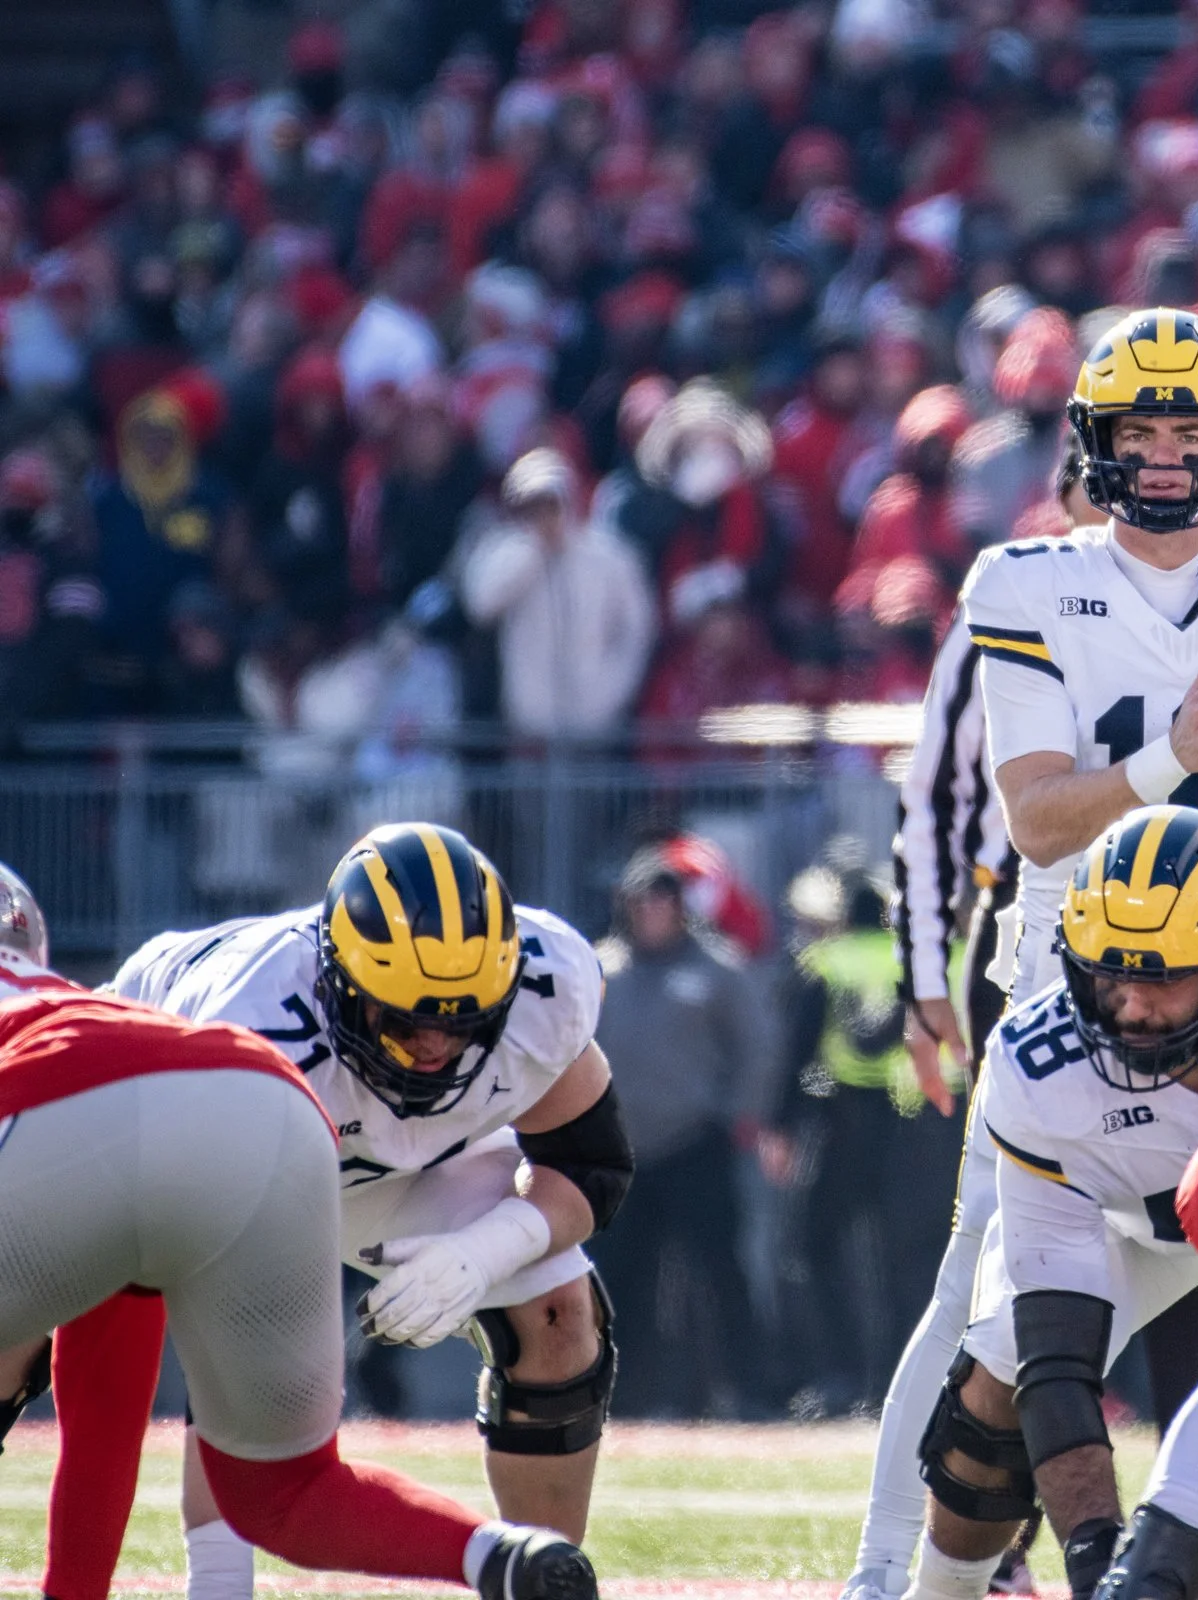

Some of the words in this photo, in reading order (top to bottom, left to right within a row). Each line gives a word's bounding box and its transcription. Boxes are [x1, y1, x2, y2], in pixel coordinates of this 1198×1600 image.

[1156, 387, 1174, 400] M
[1122, 952, 1143, 968] M
[437, 1000, 460, 1016] M
